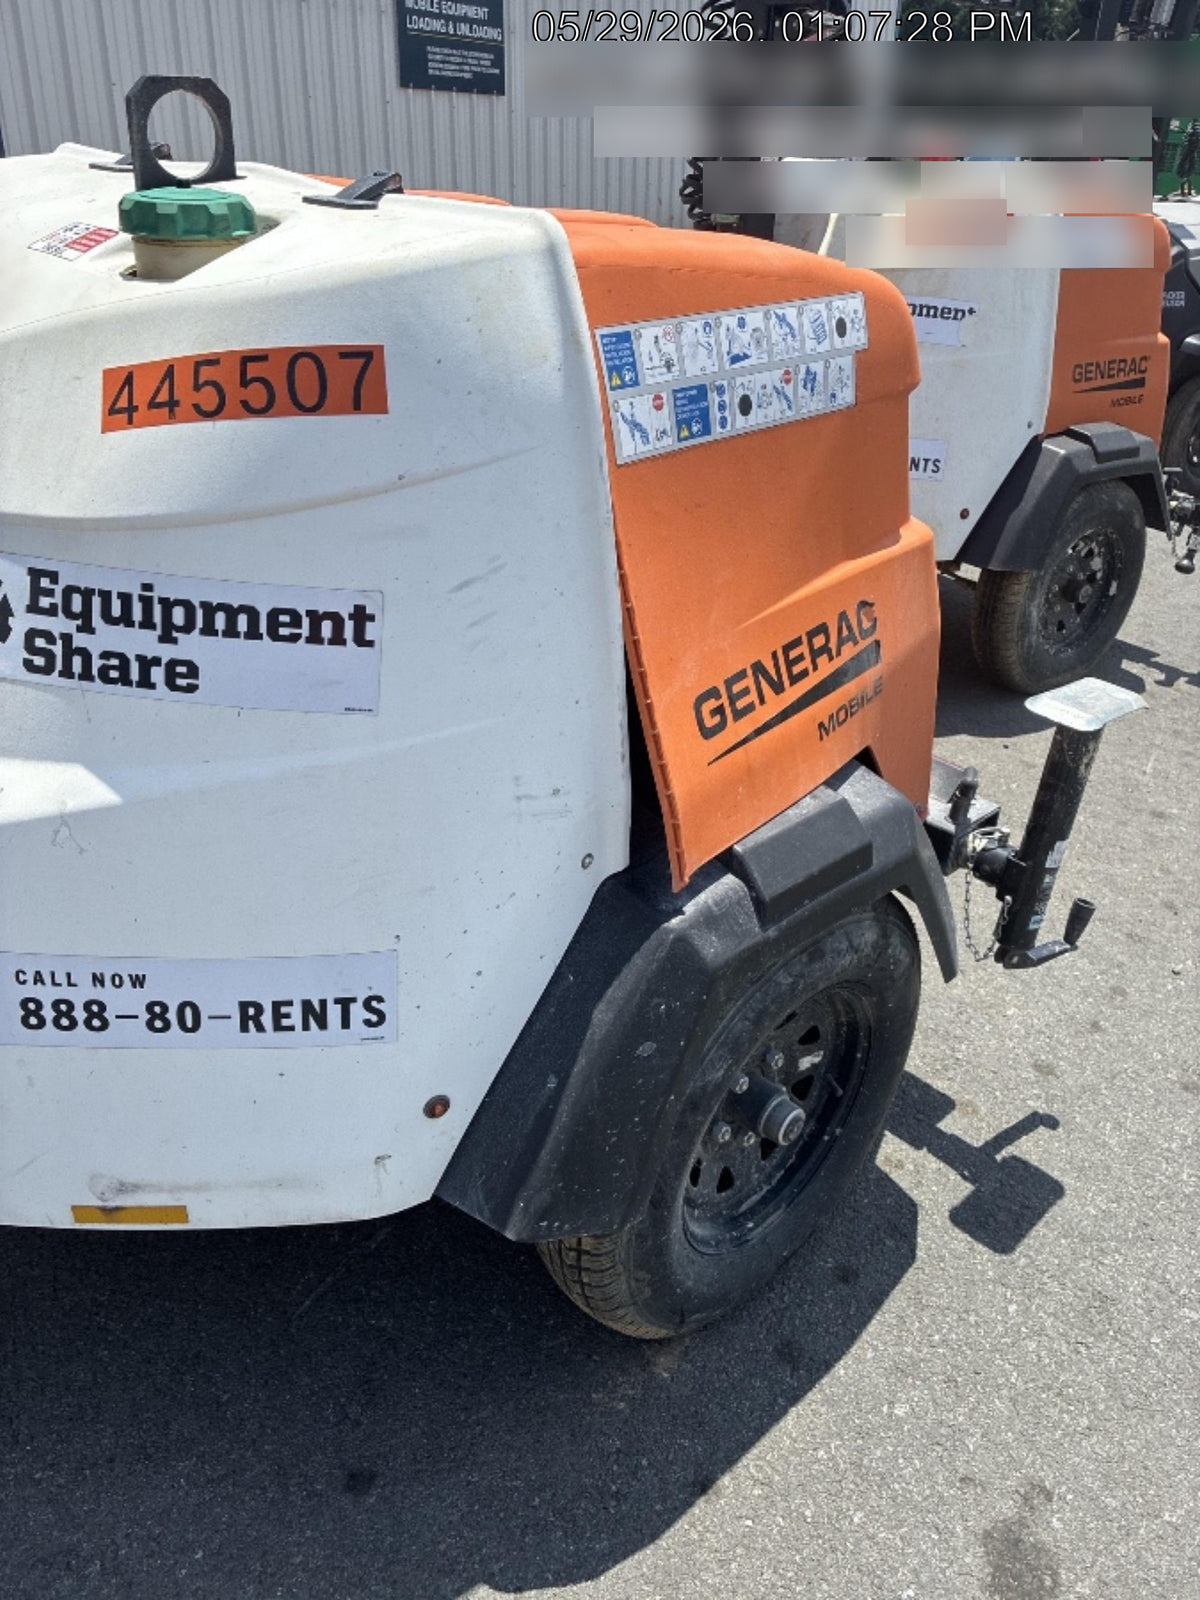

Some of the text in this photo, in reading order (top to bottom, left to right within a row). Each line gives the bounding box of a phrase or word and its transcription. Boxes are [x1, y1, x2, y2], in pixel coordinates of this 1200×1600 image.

[406, 14, 502, 40] LOADING & UNLOADING
[441, 1, 489, 20] EQUIPMENT
[107, 350, 374, 426] 445507
[1072, 355, 1148, 384] GENERAC
[910, 456, 941, 473] NTS
[25, 566, 375, 648] Equipment
[22, 627, 200, 694] Share
[694, 600, 878, 740] GENERAC
[817, 675, 883, 742] MOBILE
[15, 969, 146, 989] CALL NOW
[19, 995, 387, 1034] 888-80-RENTS
